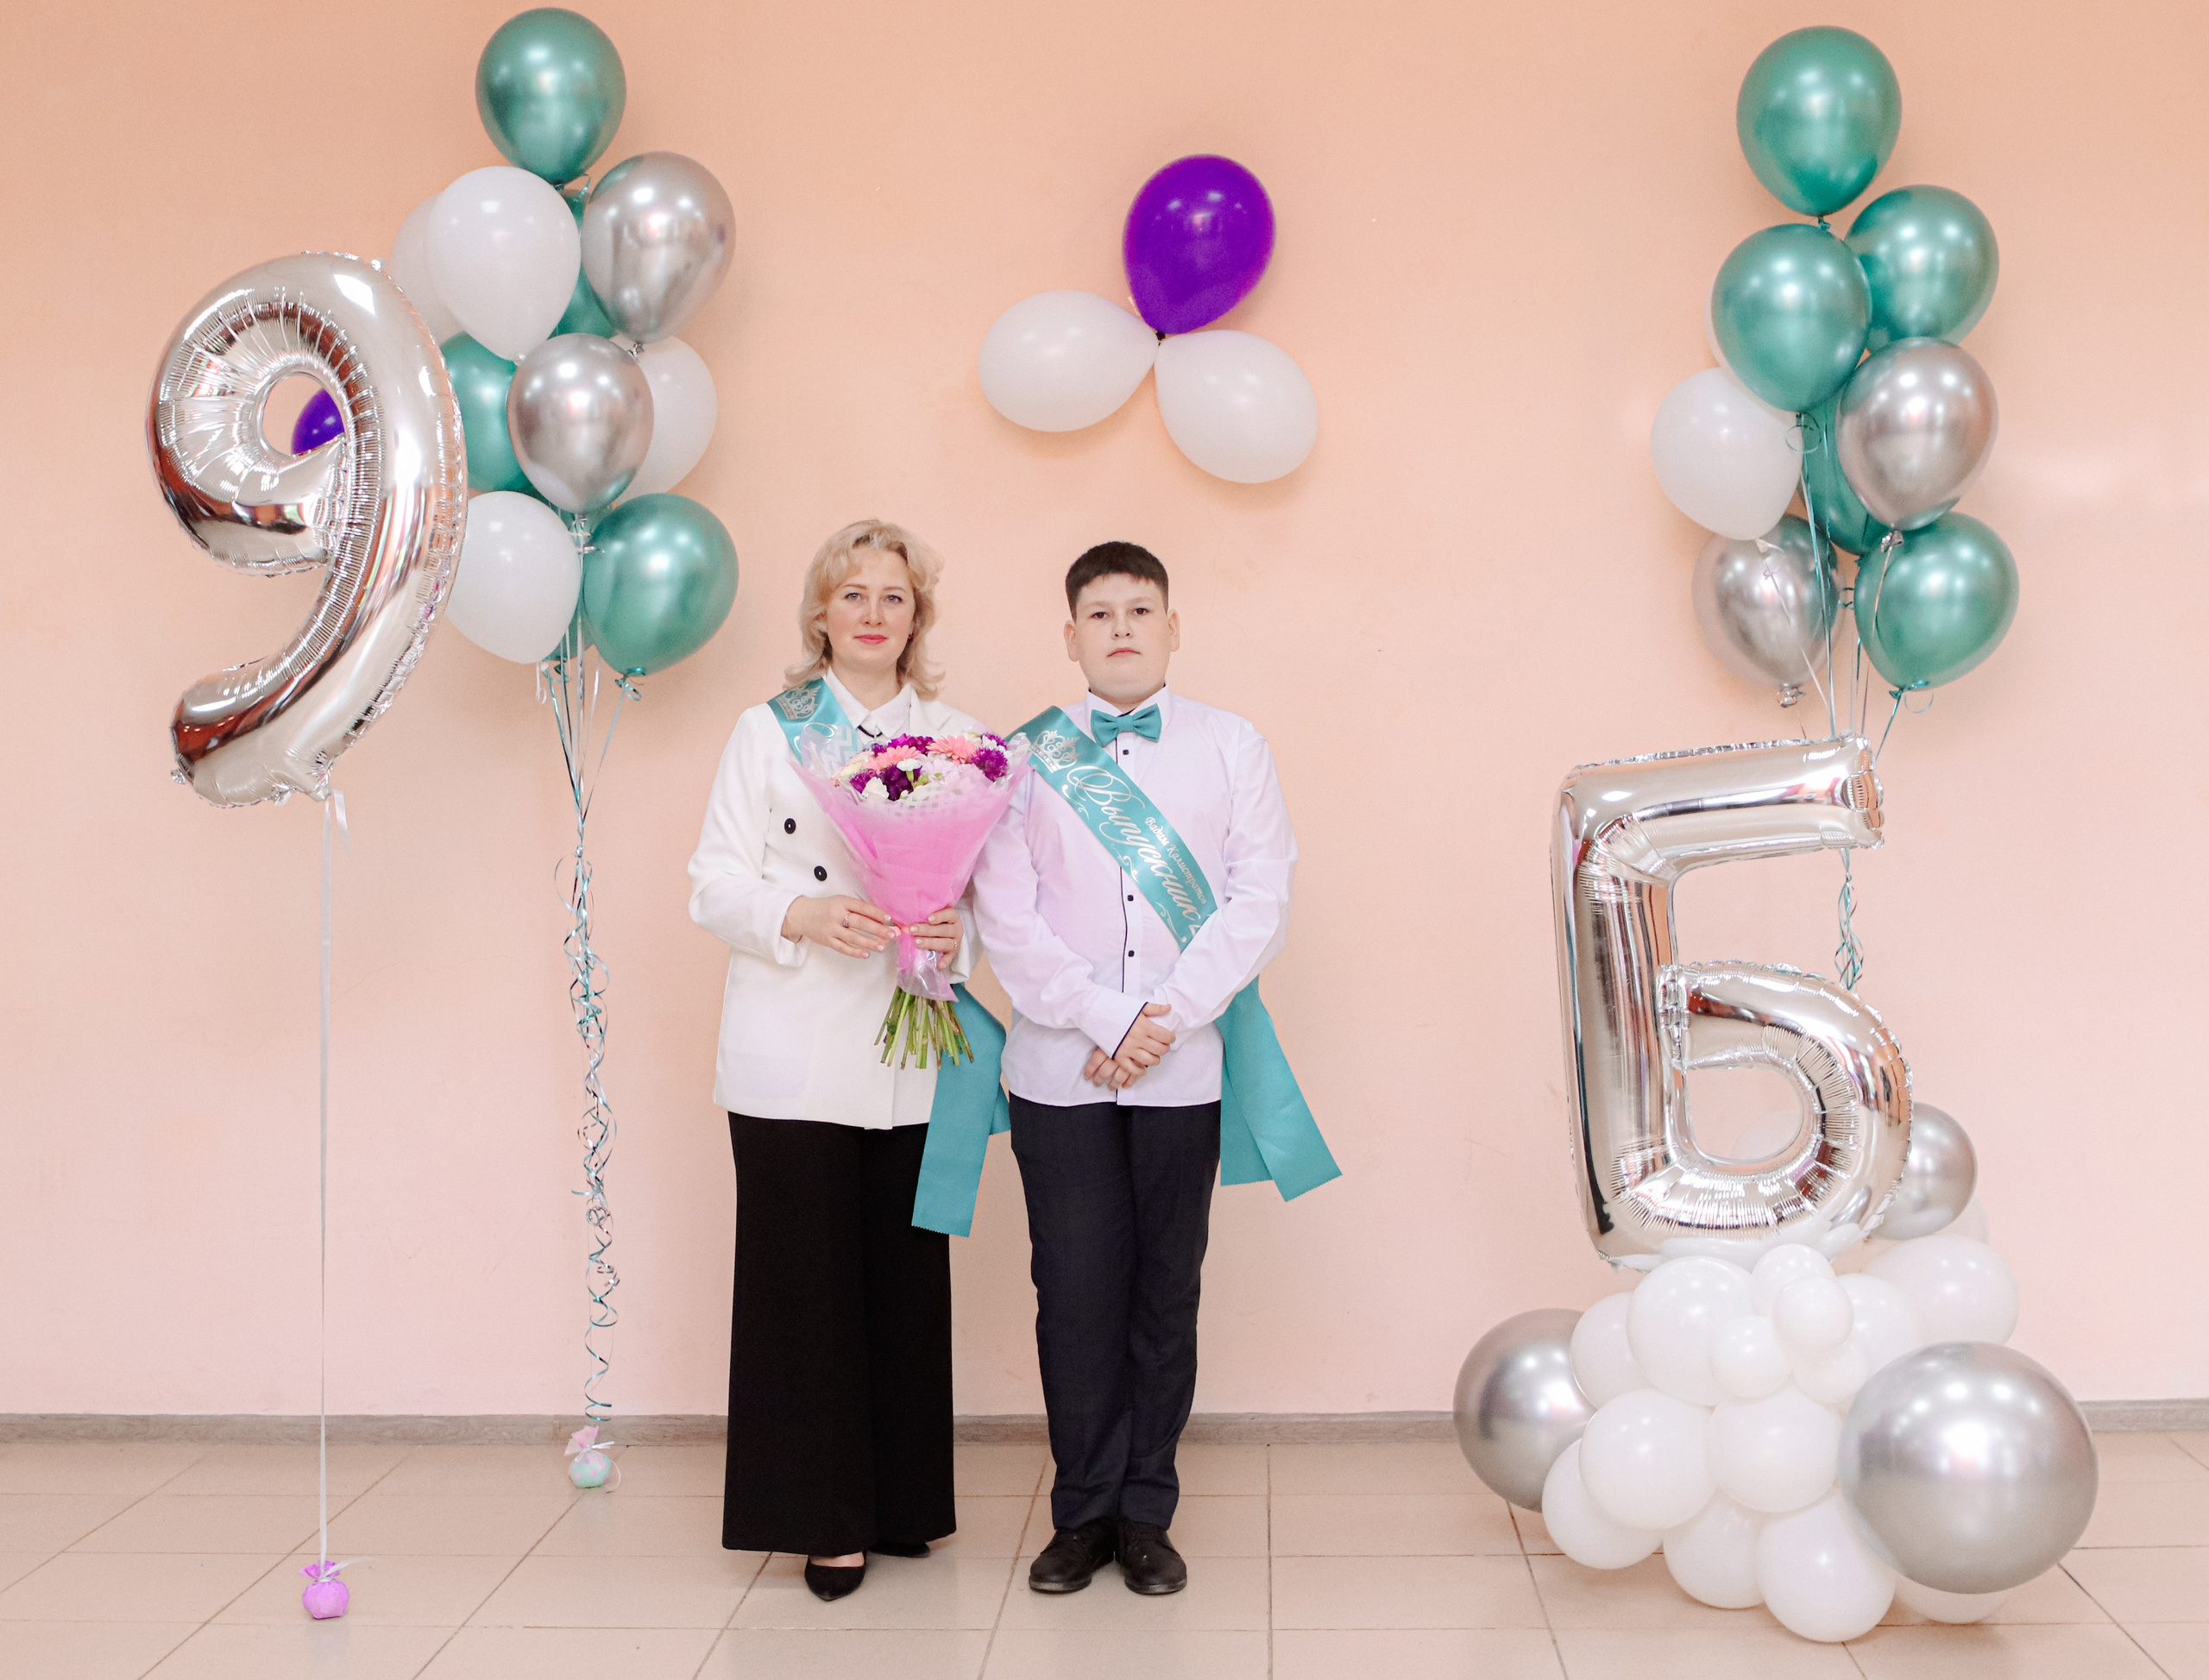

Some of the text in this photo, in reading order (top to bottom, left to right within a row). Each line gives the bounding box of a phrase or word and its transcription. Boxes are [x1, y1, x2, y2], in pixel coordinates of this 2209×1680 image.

[147, 251, 469, 808] 9
[1067, 765, 1200, 922] Выпускник
[1144, 816, 1169, 846] Вадим
[1551, 733, 1913, 1270] Б
